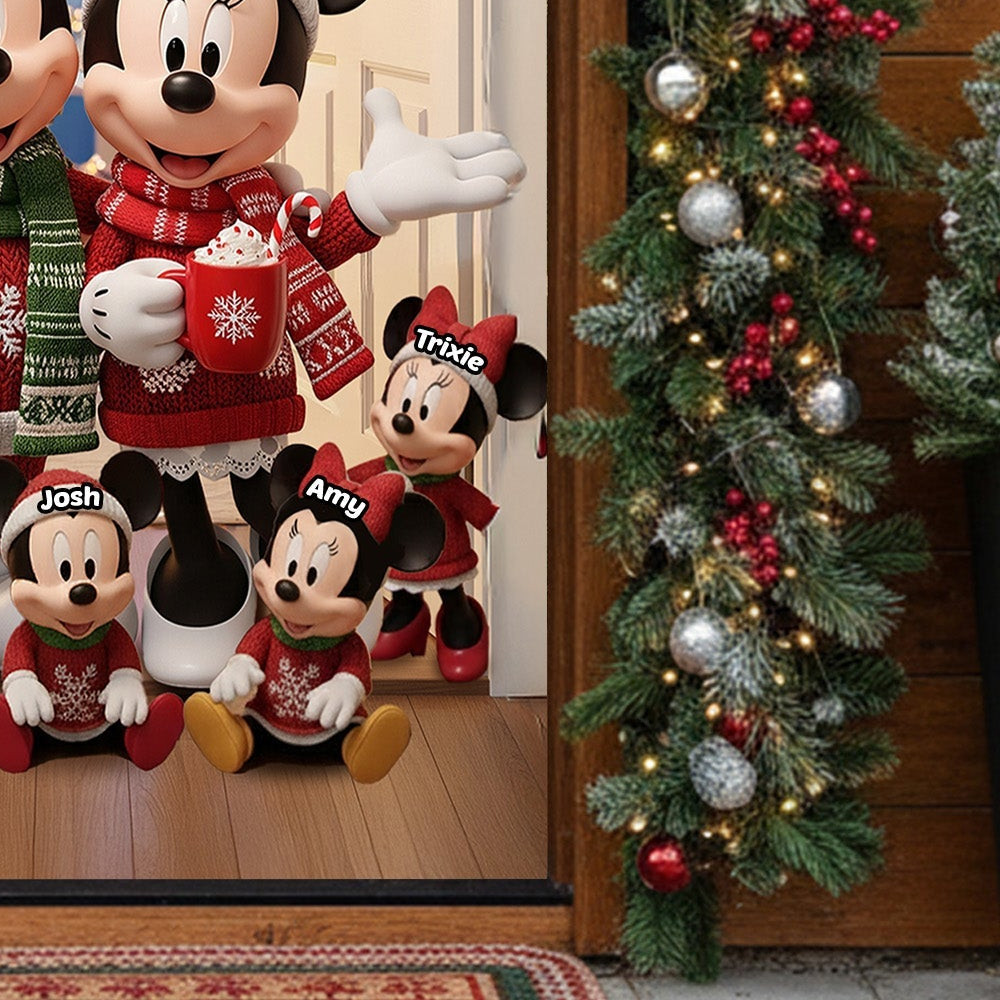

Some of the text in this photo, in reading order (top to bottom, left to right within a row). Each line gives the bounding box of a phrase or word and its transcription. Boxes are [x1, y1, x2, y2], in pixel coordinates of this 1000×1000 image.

[413, 328, 486, 374] Trixie
[39, 485, 102, 512] Josh
[305, 477, 367, 519] Amy
